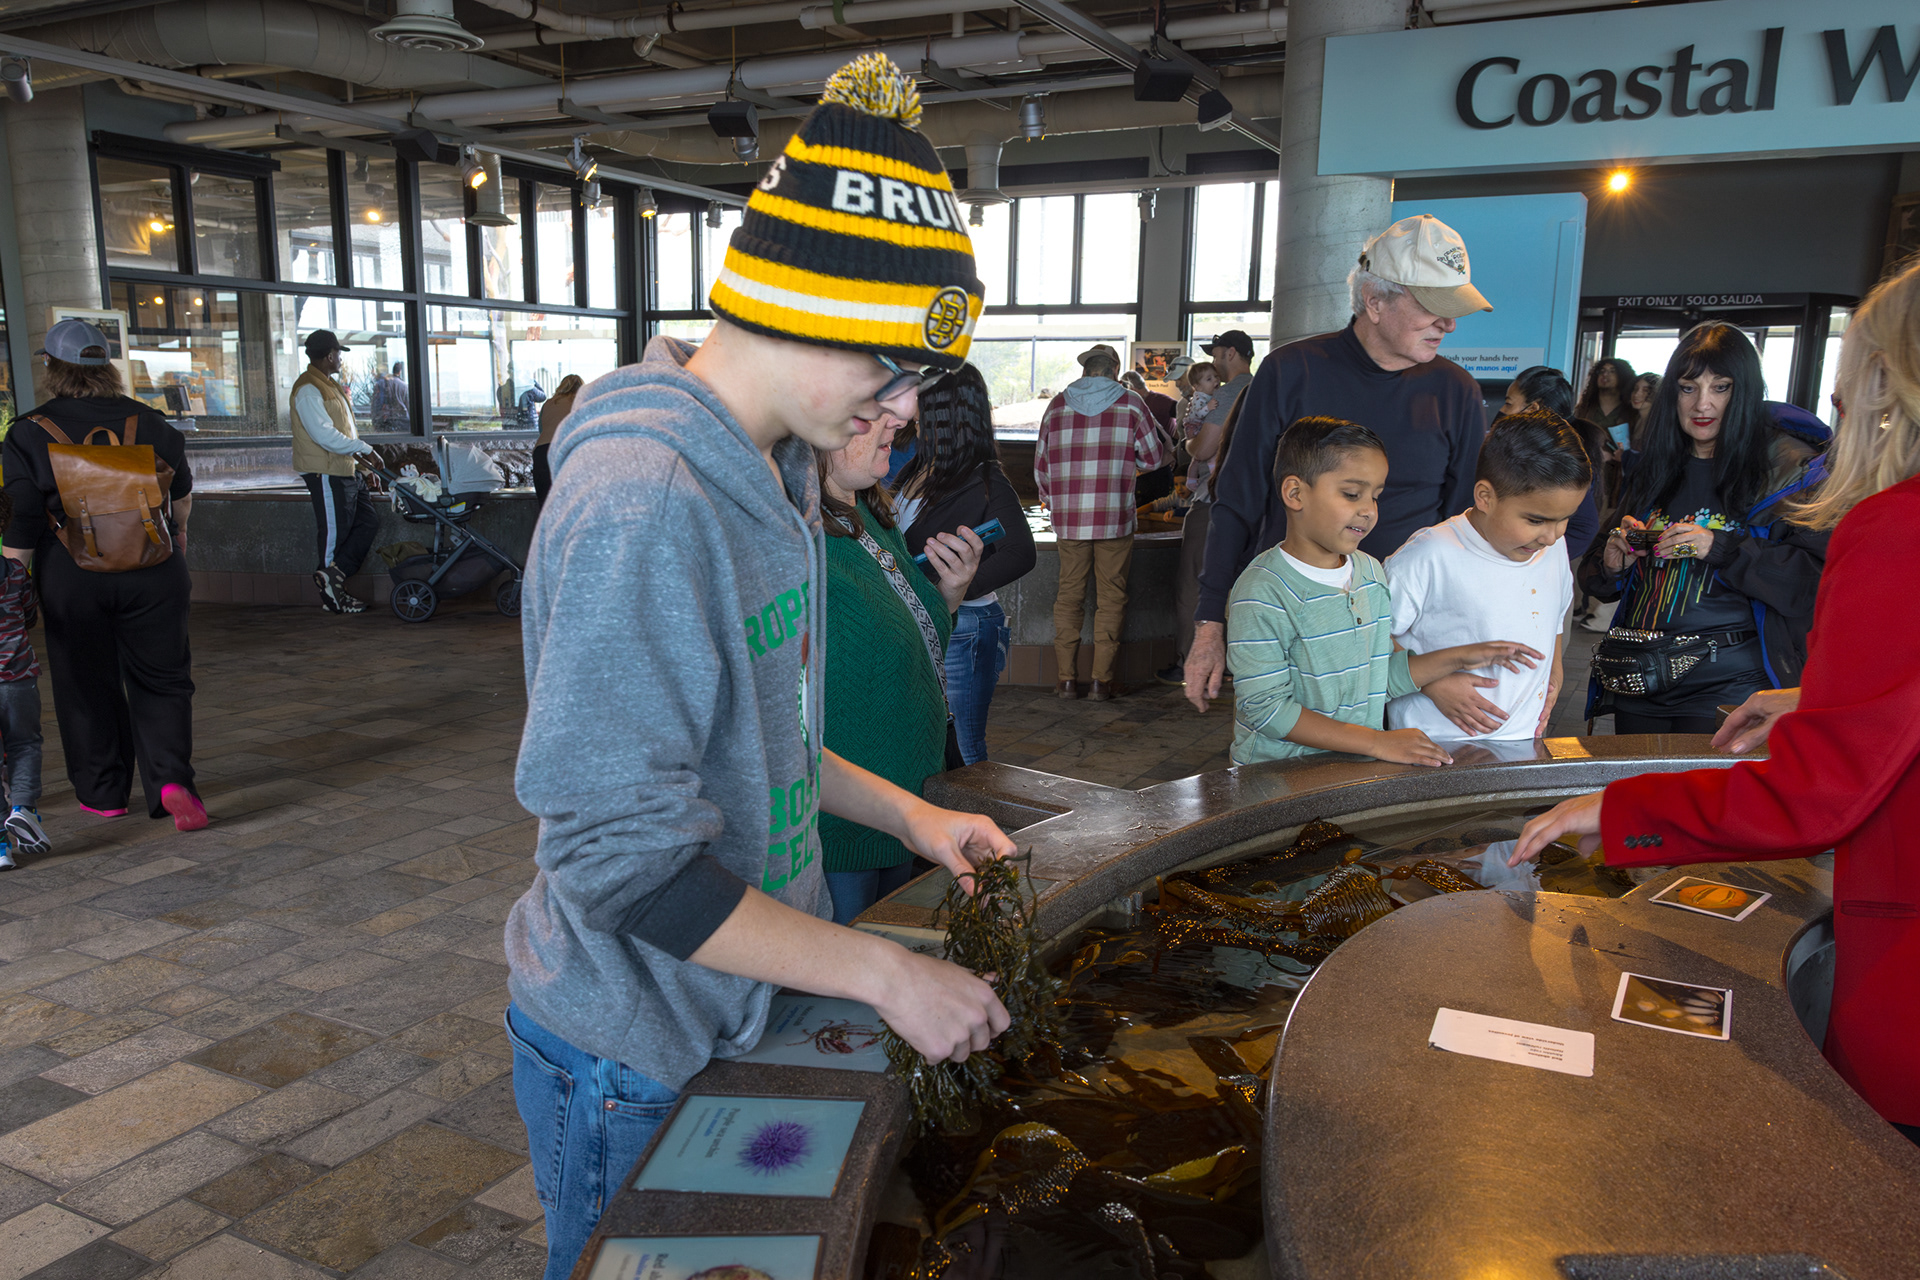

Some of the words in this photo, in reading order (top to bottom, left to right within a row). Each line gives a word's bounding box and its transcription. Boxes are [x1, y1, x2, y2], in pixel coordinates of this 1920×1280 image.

[1456, 26, 1784, 130] Coastal
[1617, 297, 1643, 306] EXIT
[1646, 296, 1678, 306] ONLY
[1686, 295, 1718, 306] SOLO
[1720, 294, 1764, 304] SALIDA
[1501, 364, 1518, 372] aquí
[744, 581, 809, 662] ROP
[723, 1108, 740, 1126] Purple
[704, 1138, 721, 1158] urchin
